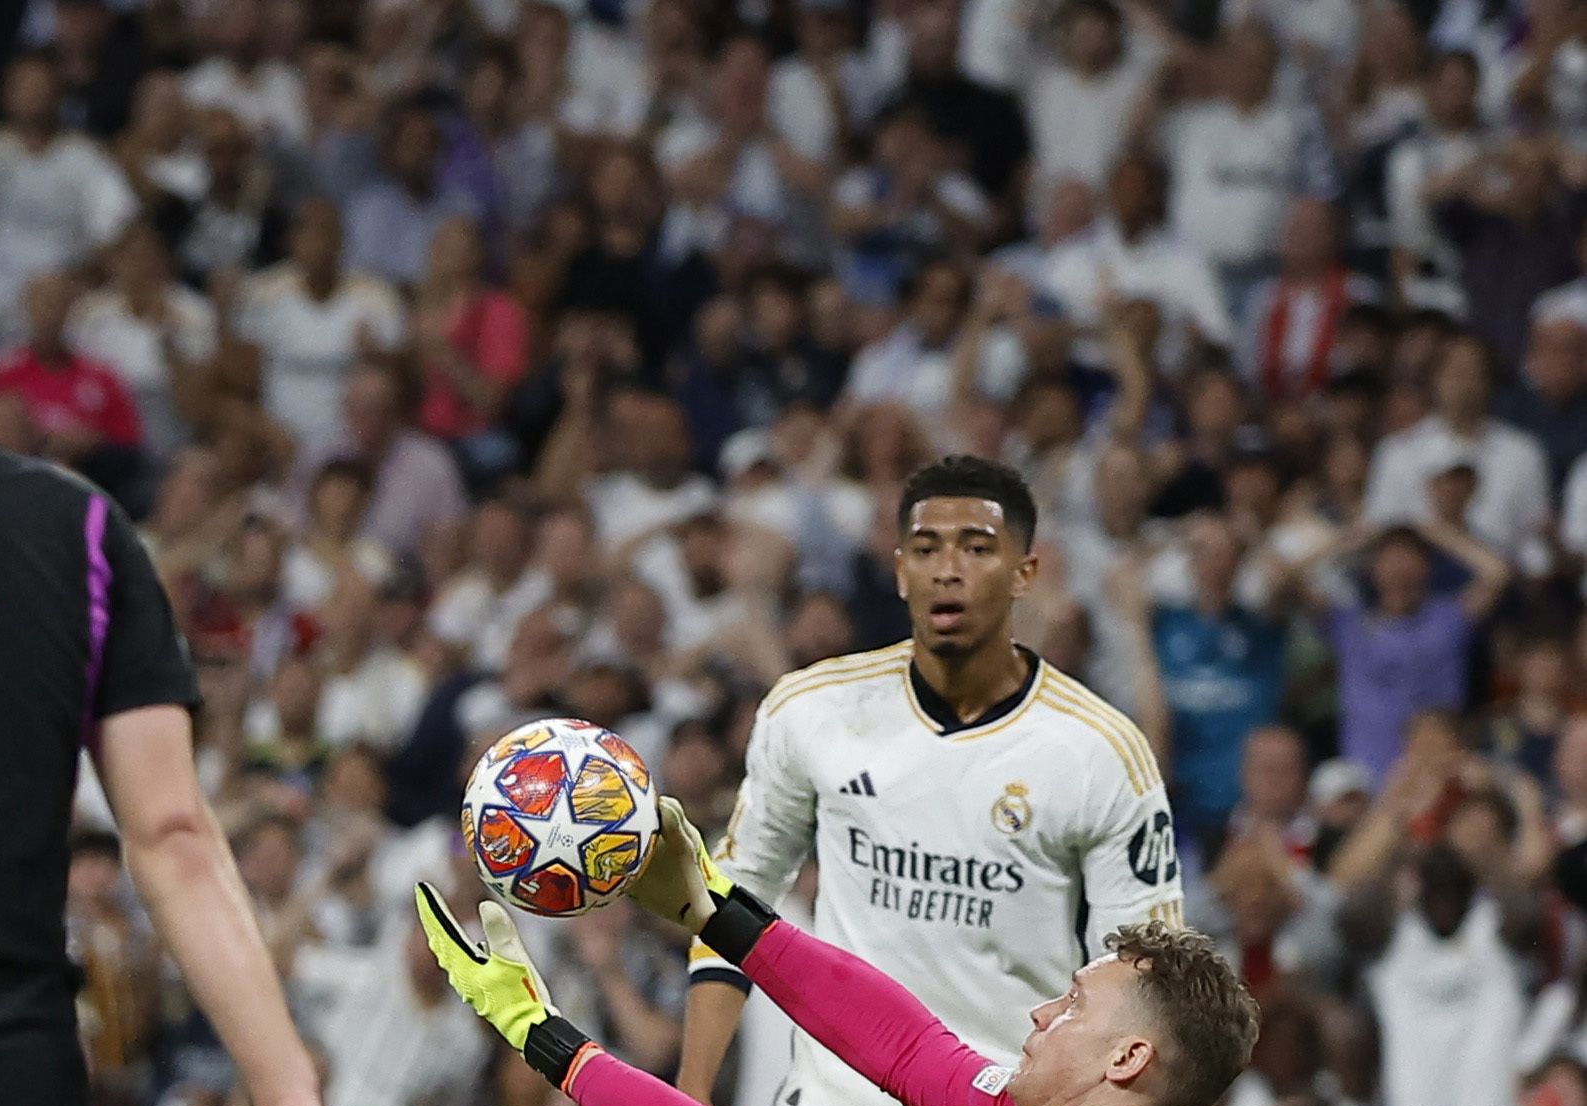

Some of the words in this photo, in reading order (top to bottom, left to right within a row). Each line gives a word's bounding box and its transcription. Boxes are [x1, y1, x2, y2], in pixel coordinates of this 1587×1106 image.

[847, 825, 1026, 894] Emirates
[1129, 810, 1177, 887] hp
[869, 877, 902, 912] FLY
[907, 888, 995, 930] BETTER
